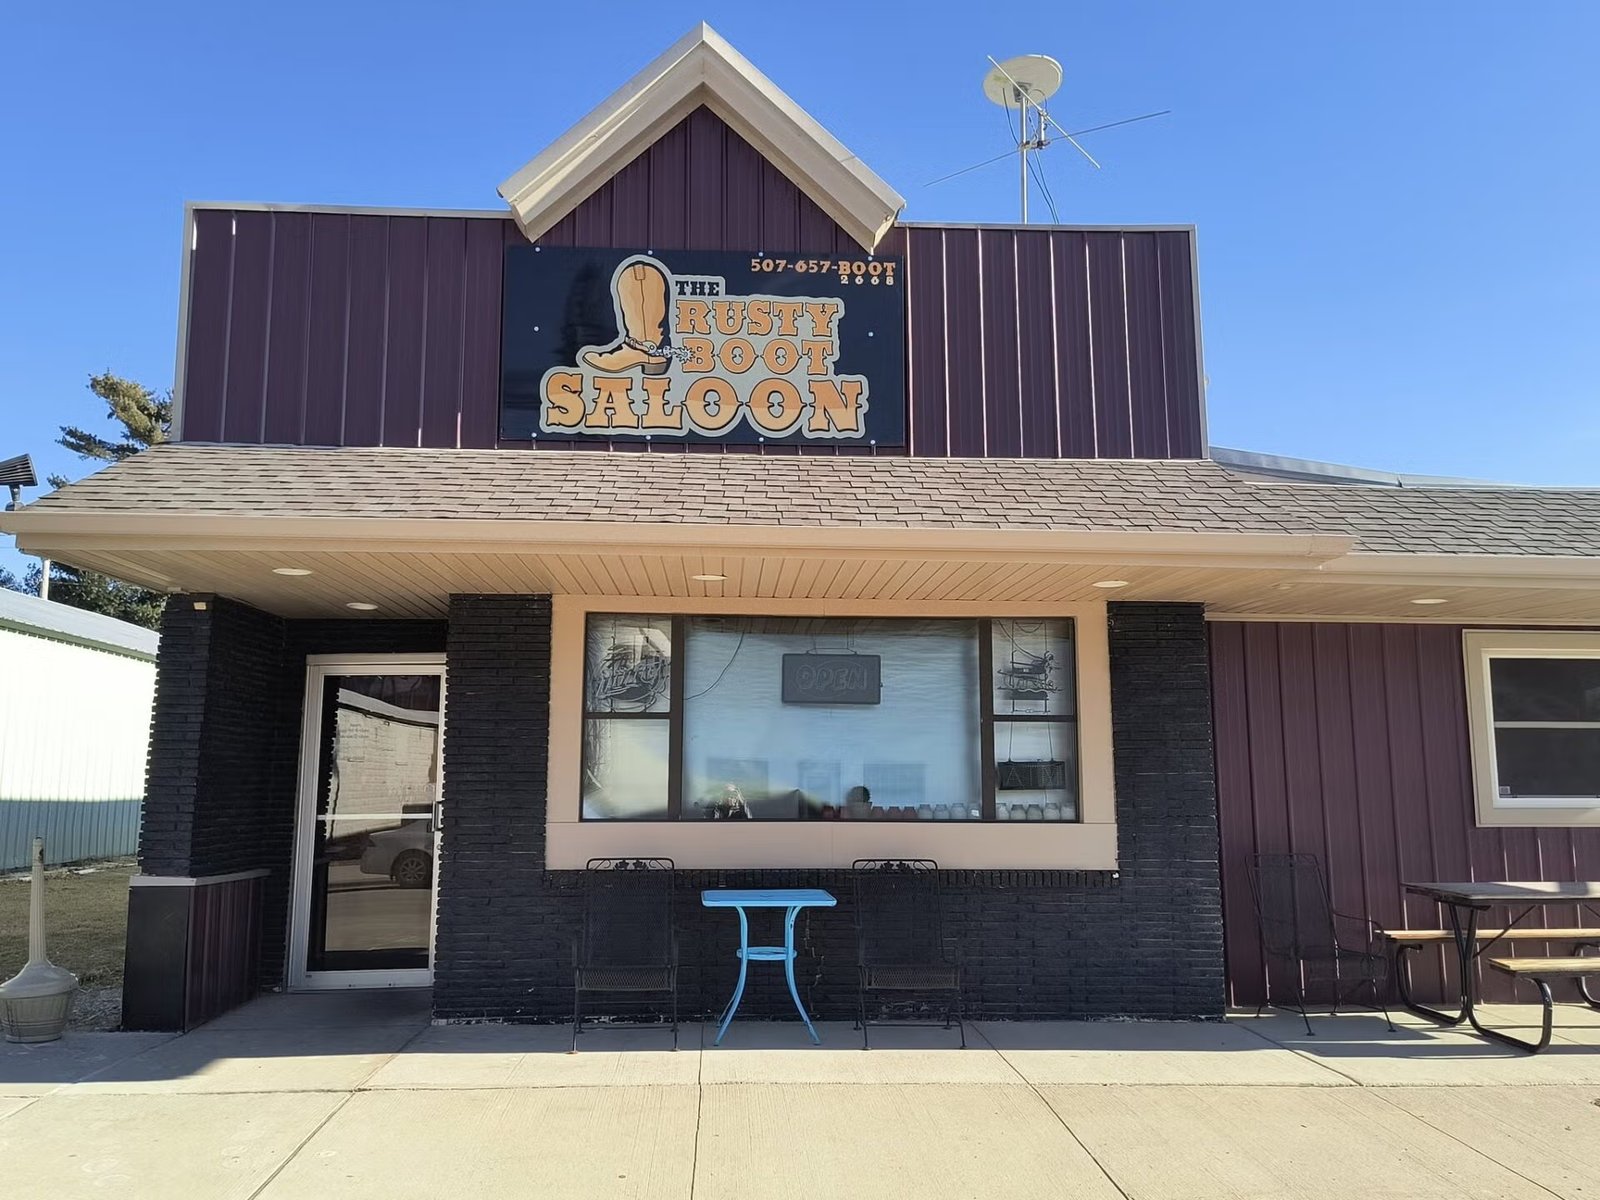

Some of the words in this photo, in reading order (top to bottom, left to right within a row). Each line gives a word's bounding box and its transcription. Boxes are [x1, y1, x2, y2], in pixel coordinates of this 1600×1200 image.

[751, 258, 896, 276] 507-657-BOOT
[677, 280, 720, 296] THE
[840, 275, 895, 286] 2668
[676, 300, 838, 336] RUSTY
[681, 339, 834, 375] BOOT
[546, 372, 863, 432] SALOON
[796, 664, 867, 690] OPEN
